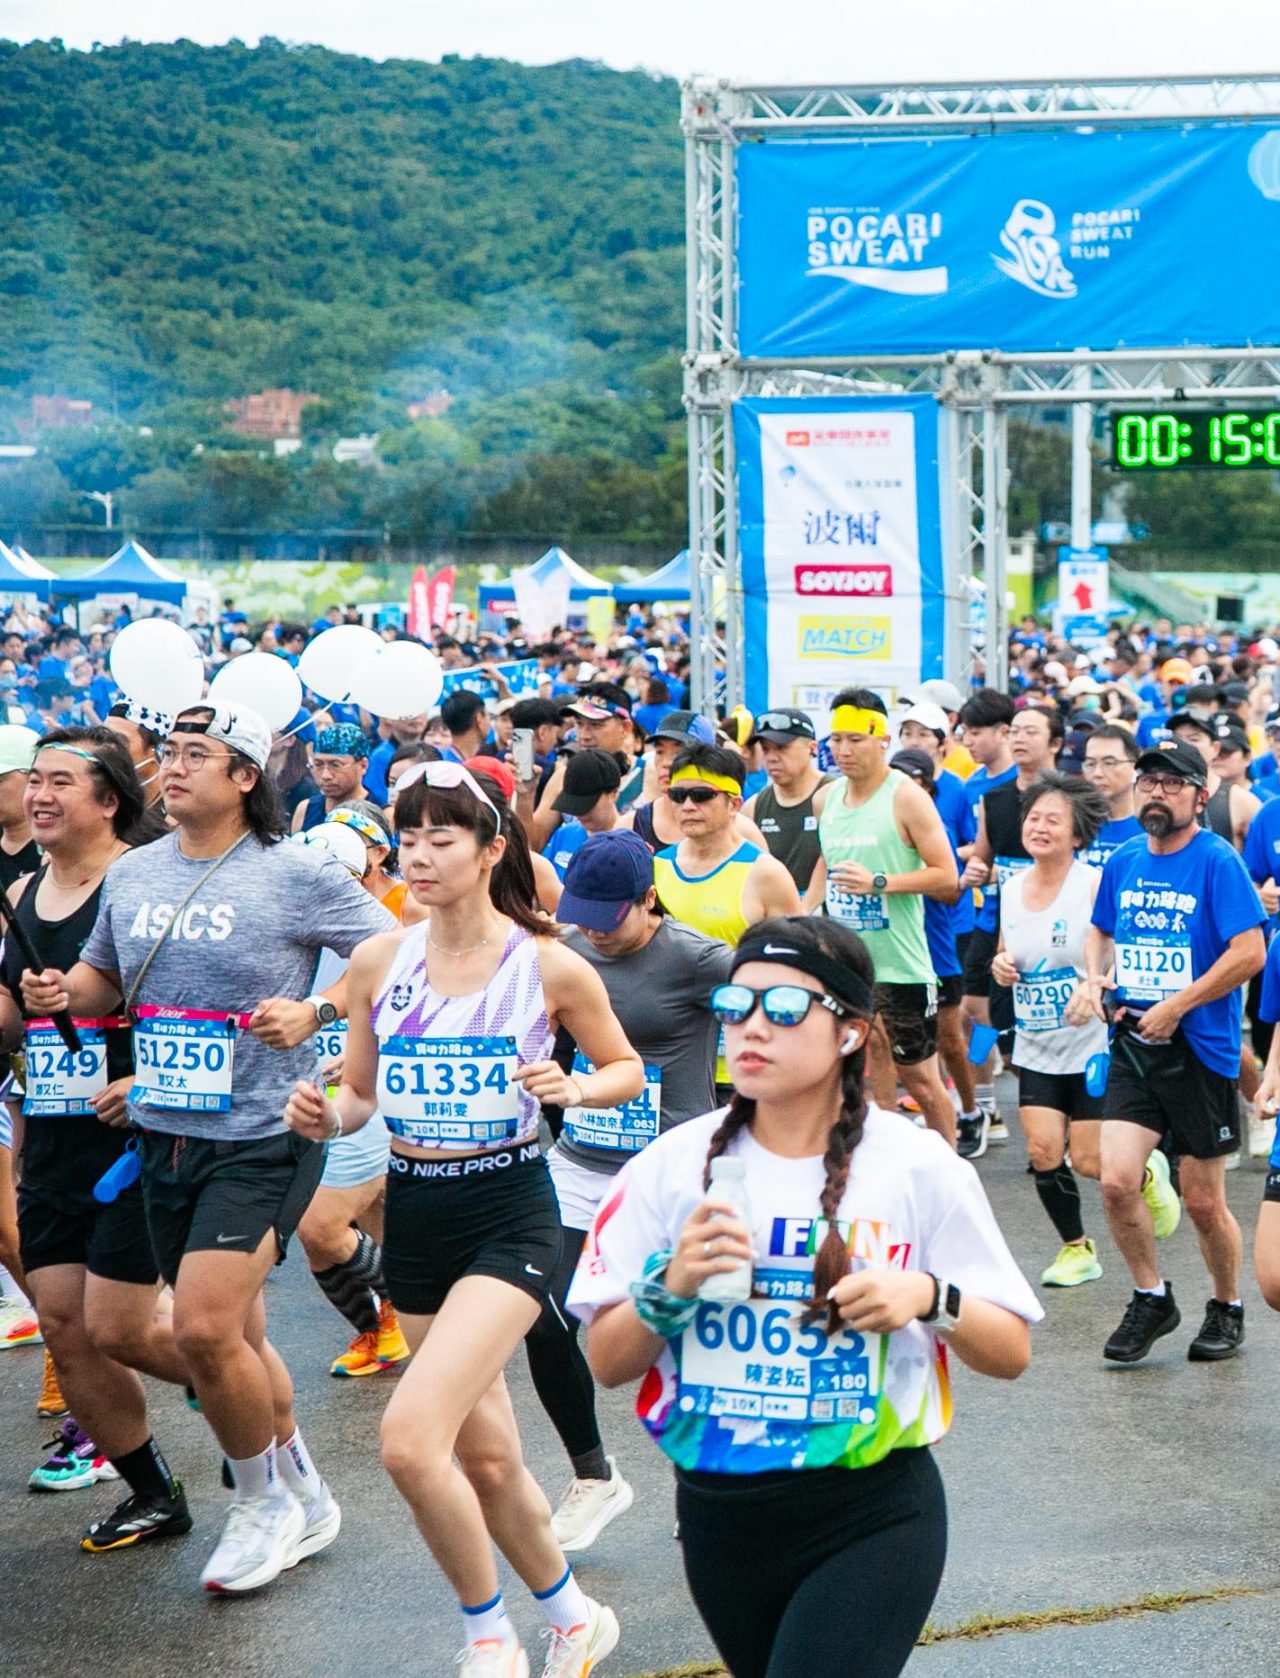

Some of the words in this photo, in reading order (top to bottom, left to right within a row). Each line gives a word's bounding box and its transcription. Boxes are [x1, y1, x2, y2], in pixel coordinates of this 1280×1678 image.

[807, 212, 941, 241] POCARI
[1072, 209, 1140, 226] POCARI
[1071, 226, 1133, 243] SWEAT
[808, 238, 929, 267] SWEAT
[1070, 245, 1110, 259] RUN
[804, 510, 881, 546] 波爾
[800, 570, 888, 592] SOYJOY
[804, 629, 885, 652] MATCH
[129, 902, 235, 940] ASICS
[1122, 949, 1185, 973] 51120
[27, 1050, 98, 1078] 1249
[139, 1037, 224, 1072] 51250
[386, 1062, 509, 1096] 61334
[416, 1126, 437, 1135] 10K
[634, 1120, 654, 1129] 063
[413, 1162, 462, 1177] NIKE
[463, 1153, 512, 1175] PRO
[831, 1374, 867, 1390] 180
[732, 1397, 757, 1411] 10K
